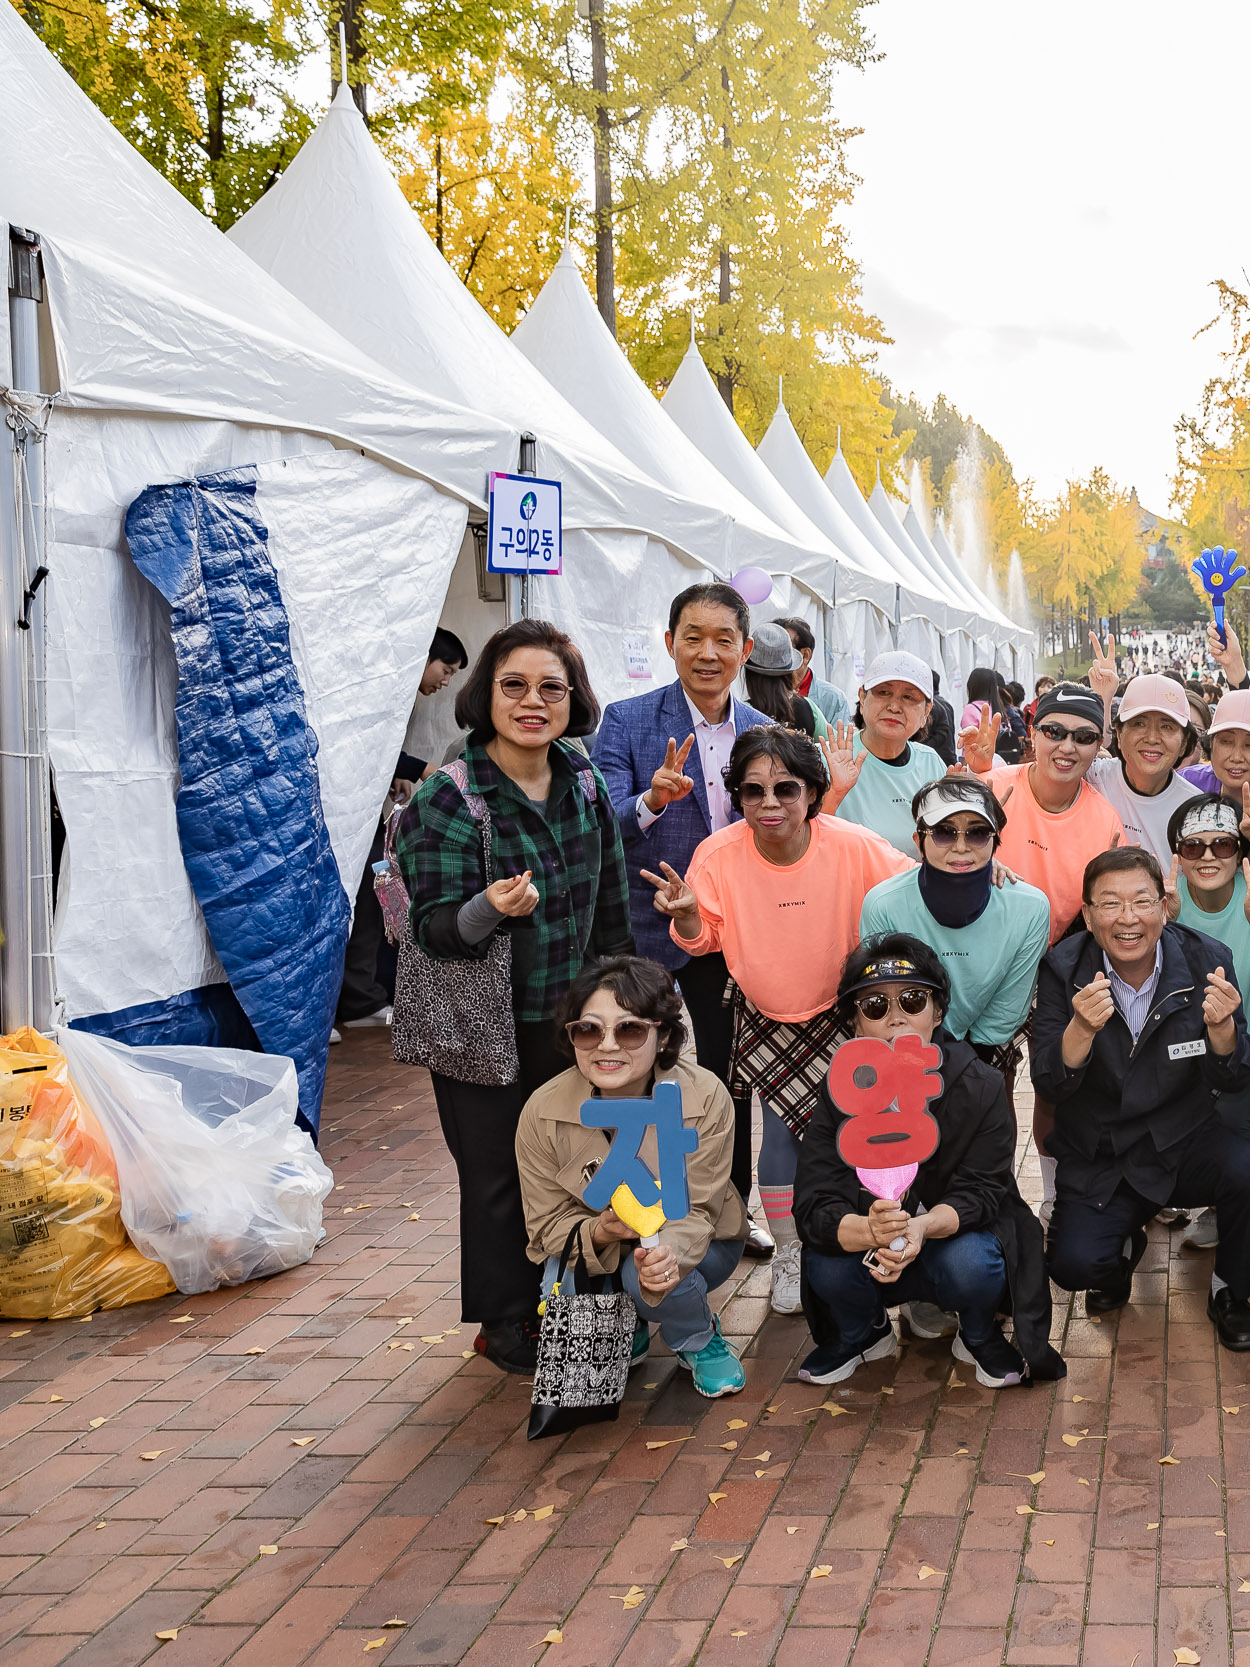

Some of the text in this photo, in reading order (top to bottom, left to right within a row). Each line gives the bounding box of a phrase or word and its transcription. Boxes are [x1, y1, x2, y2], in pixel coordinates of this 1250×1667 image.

[499, 526, 554, 561] 구의2동
[580, 1079, 699, 1220] 자
[827, 1033, 944, 1170] 양
